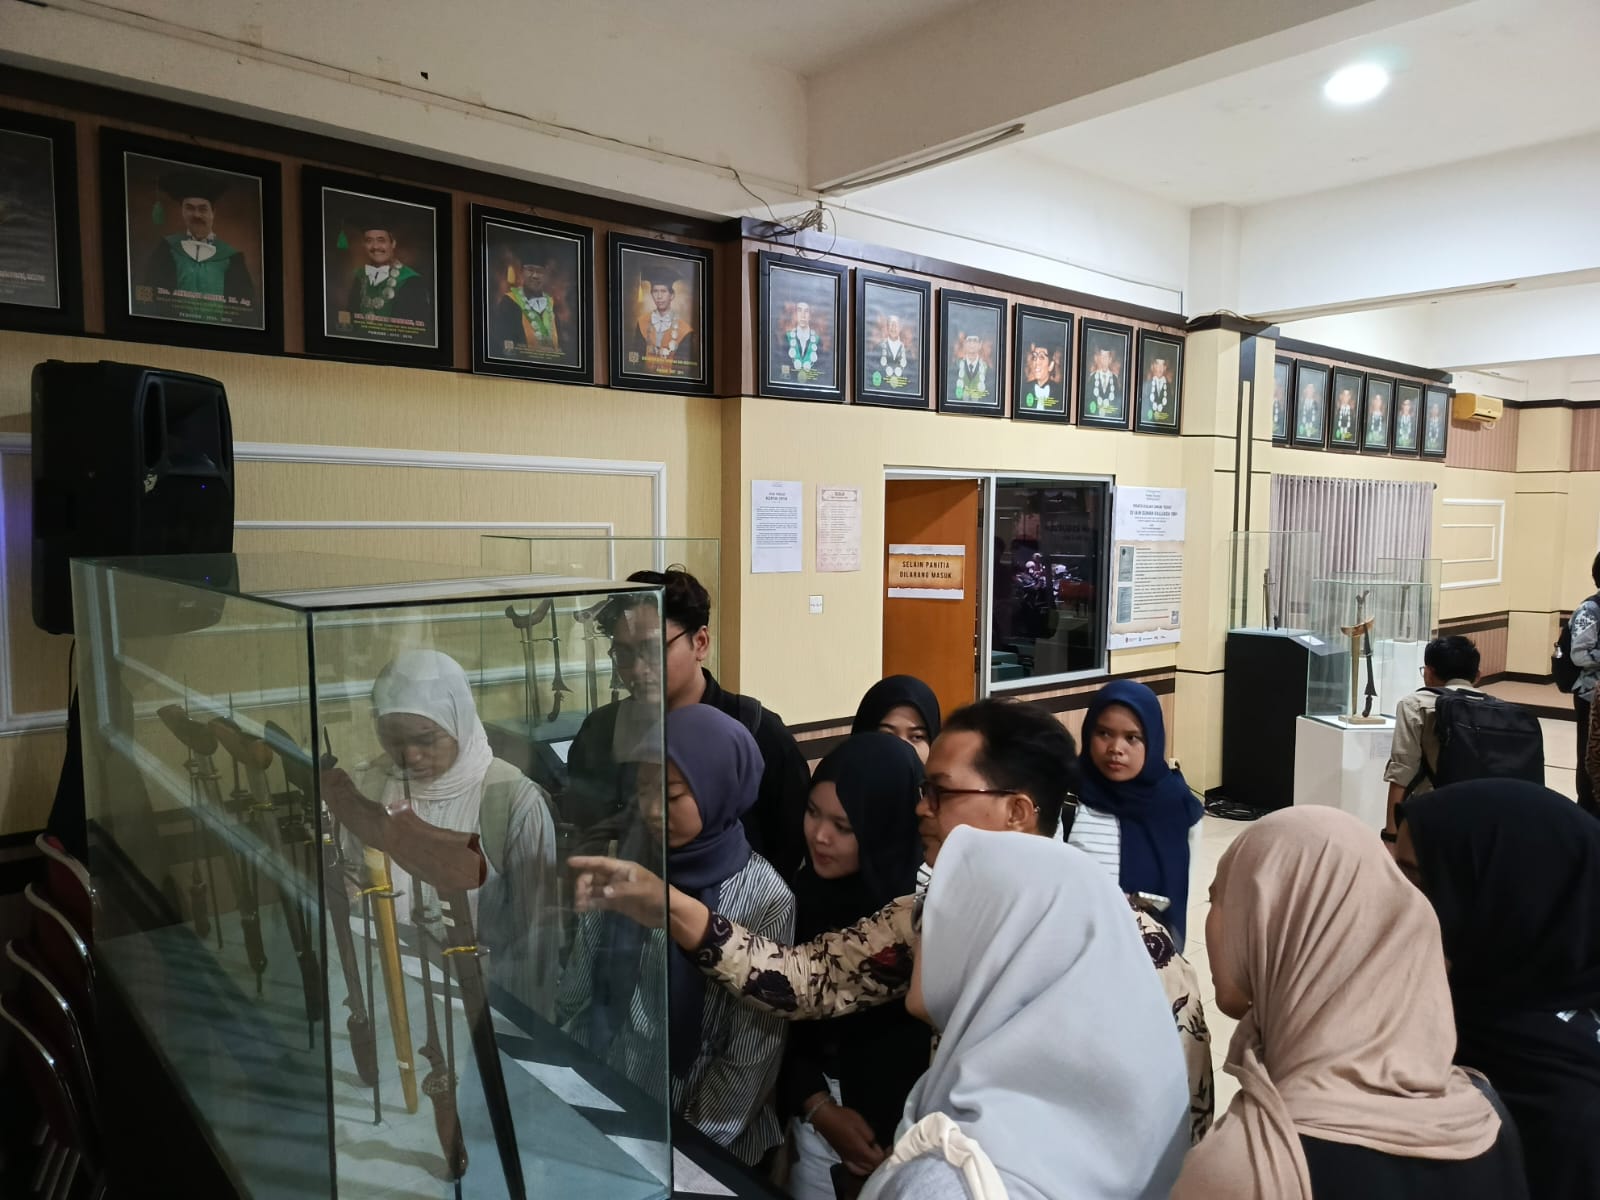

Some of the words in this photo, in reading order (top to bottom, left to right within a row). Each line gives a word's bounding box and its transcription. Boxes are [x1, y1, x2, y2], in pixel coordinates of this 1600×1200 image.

[902, 560, 924, 569] SELAIN
[925, 561, 950, 569] PANITIA
[899, 571, 929, 579] DILARANG
